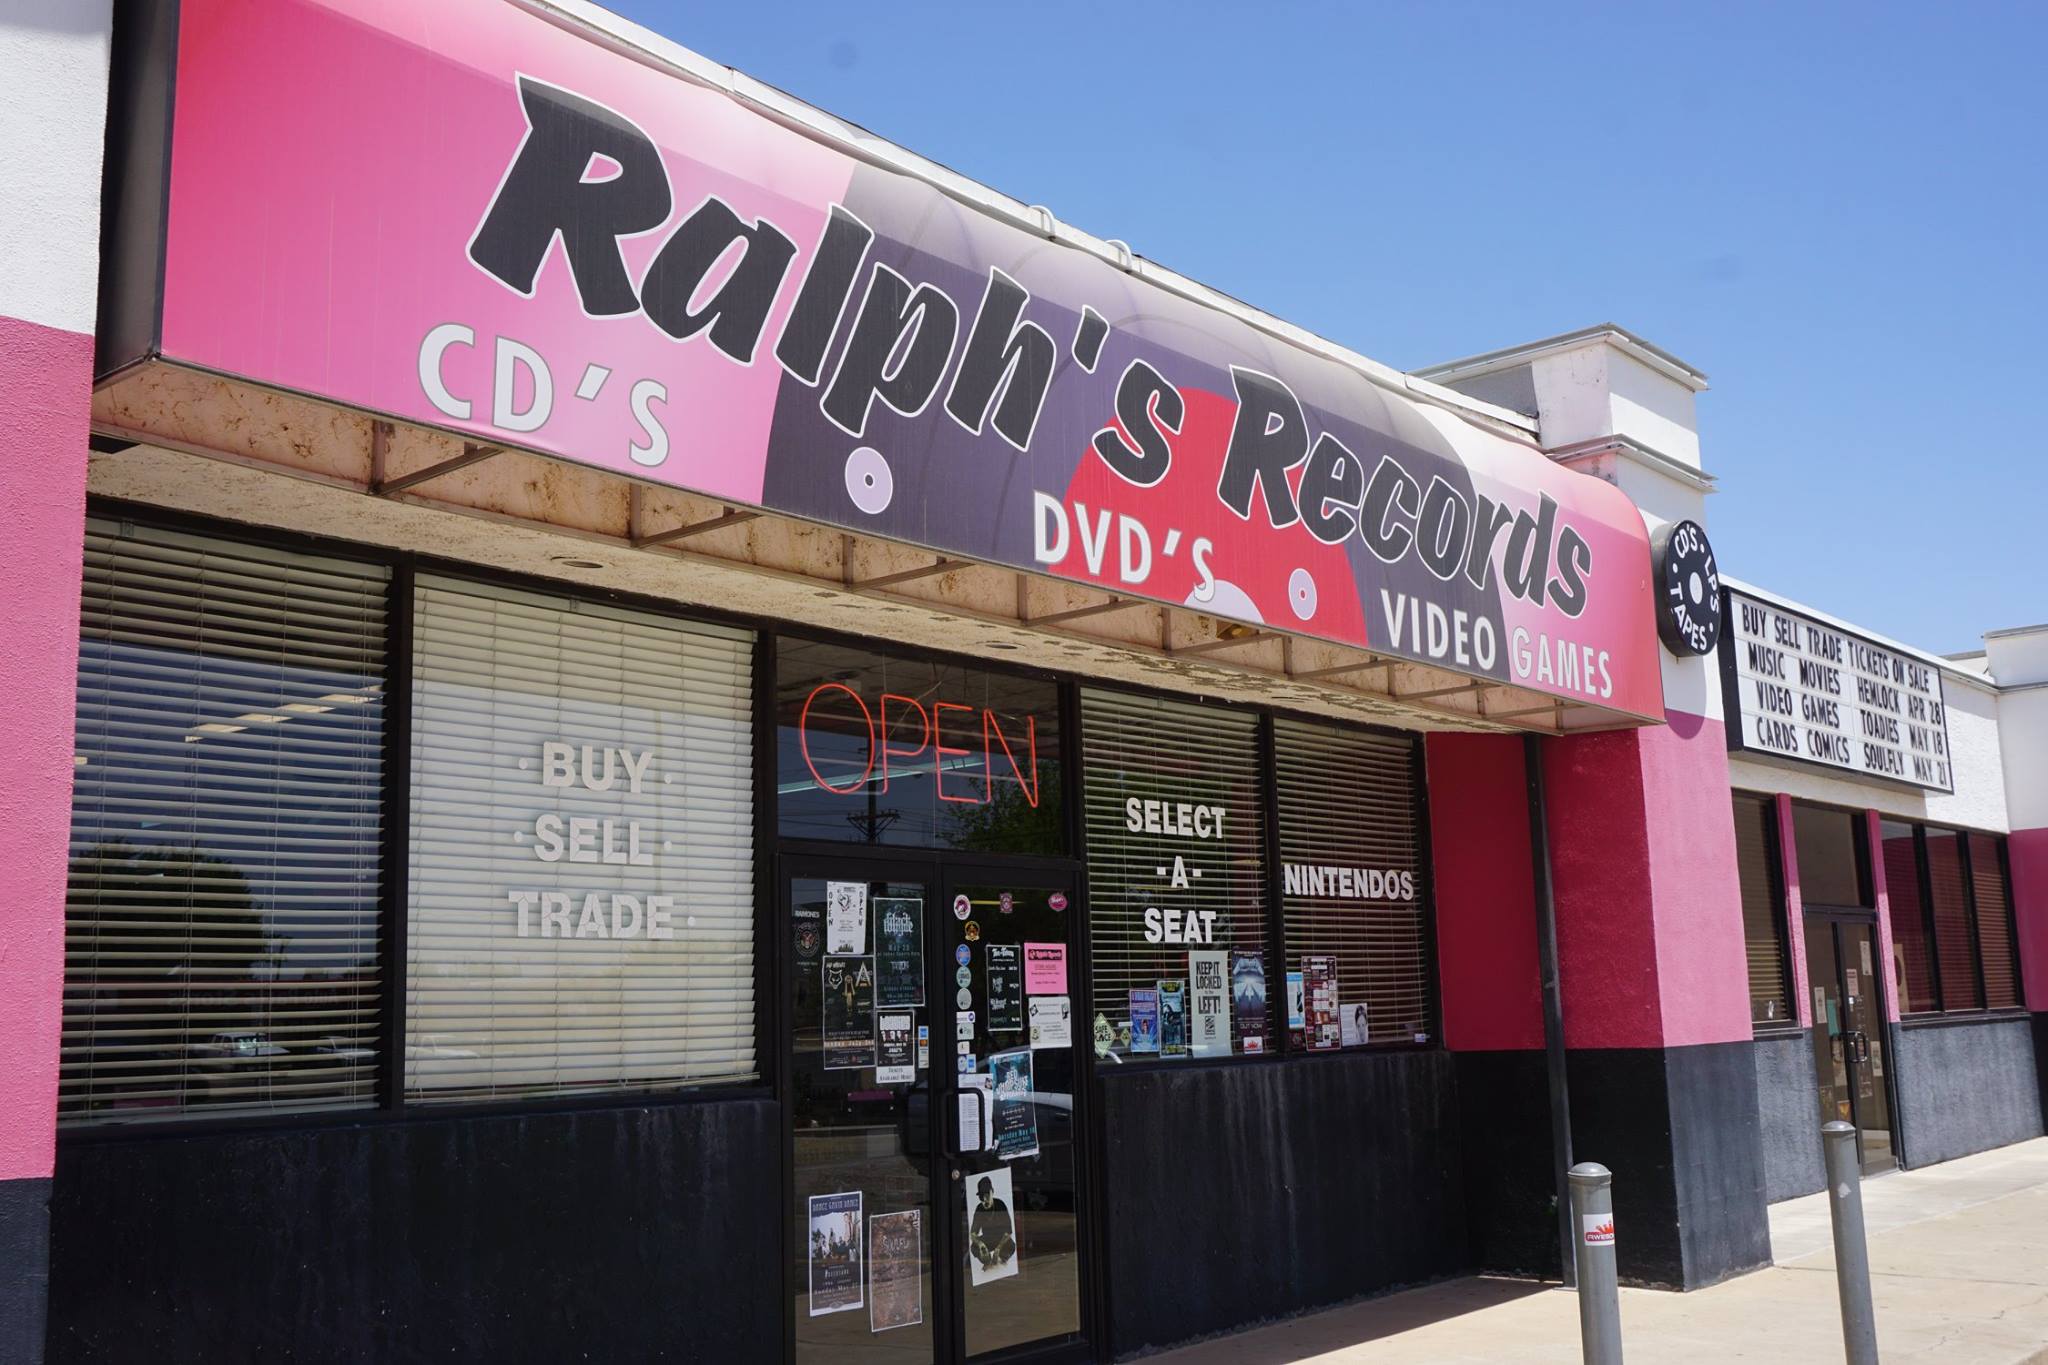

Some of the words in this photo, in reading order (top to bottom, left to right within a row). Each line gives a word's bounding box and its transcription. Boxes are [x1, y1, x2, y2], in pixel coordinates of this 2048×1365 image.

[466, 71, 1185, 488] Ralph's
[1217, 364, 1592, 618] Records
[418, 323, 670, 468] CD'S
[1033, 490, 1217, 602] DVD'S
[1675, 523, 1698, 559] CD'S
[1704, 554, 1719, 615] LP'S
[1670, 582, 1708, 652] TAPES
[1742, 604, 1767, 639] BUY
[1775, 614, 1801, 649] SELL
[1806, 626, 1843, 665] TRADE
[1379, 588, 1497, 671] VIDEO
[1512, 626, 1614, 699] GAMES
[1848, 641, 1890, 680] TICKETS
[1892, 655, 1905, 684] ON
[1908, 663, 1930, 694] SALE
[1748, 642, 1786, 680] MUSIC
[1800, 658, 1841, 696] MOVIES
[1755, 681, 1793, 717] VIDEO
[1801, 693, 1840, 729] GAMES
[1857, 676, 1901, 714] HEMLOCK
[1908, 696, 1927, 722] APR
[1929, 702, 1941, 726] 28
[801, 682, 1039, 808] OPEN
[1756, 716, 1798, 753] CARDS
[1807, 728, 1850, 764] COMICS
[1860, 709, 1900, 745] TOADIES
[1909, 727, 1929, 753] MAY
[1933, 732, 1943, 755] 18
[542, 741, 654, 794] BUY
[1864, 743, 1904, 776] SOULFLY
[1914, 760, 1935, 783] MAY
[1937, 765, 1947, 786] 21
[534, 814, 654, 866] SELL
[1126, 797, 1225, 839] SELECT
[1283, 864, 1414, 901] NINTENDOS
[508, 890, 673, 939] TRADE
[1144, 908, 1216, 943] SEAT
[1196, 961, 1213, 975] KEEP
[1196, 976, 1222, 989] LOCKED
[1198, 996, 1221, 1014] LEFT!
